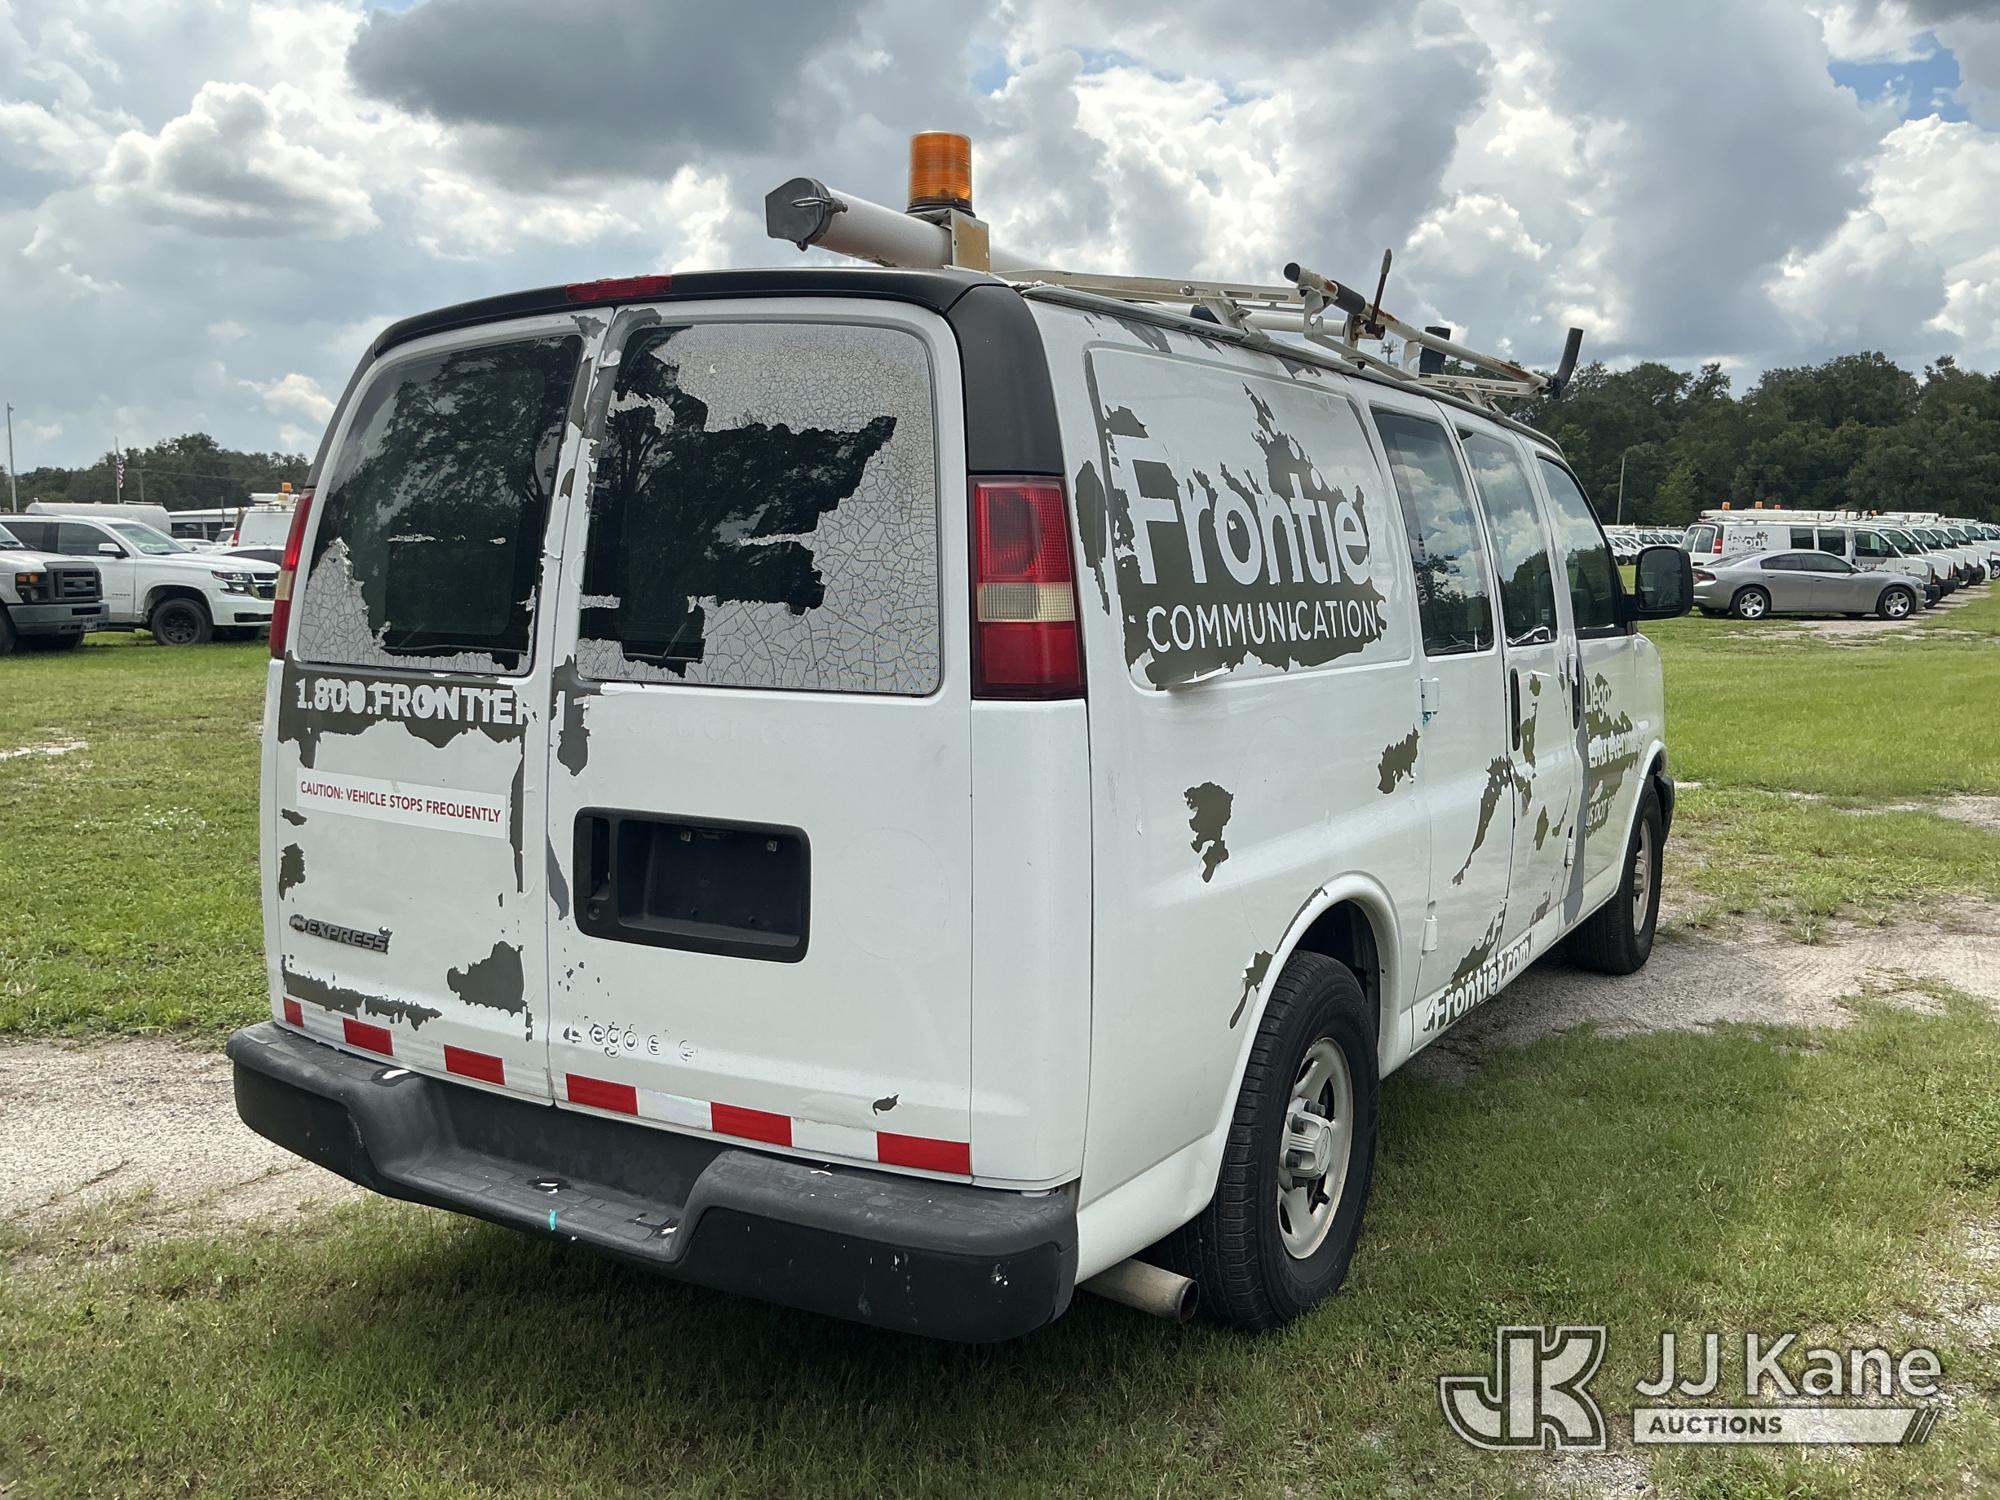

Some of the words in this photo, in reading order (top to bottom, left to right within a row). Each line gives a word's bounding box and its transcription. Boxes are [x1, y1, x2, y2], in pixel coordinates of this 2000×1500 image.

[300, 780, 344, 801] CAUTION:
[346, 788, 387, 807] VEHICLE
[389, 795, 423, 812] STOPS
[425, 801, 501, 824] FREQUENTLY
[306, 918, 387, 953] EXPRESS
